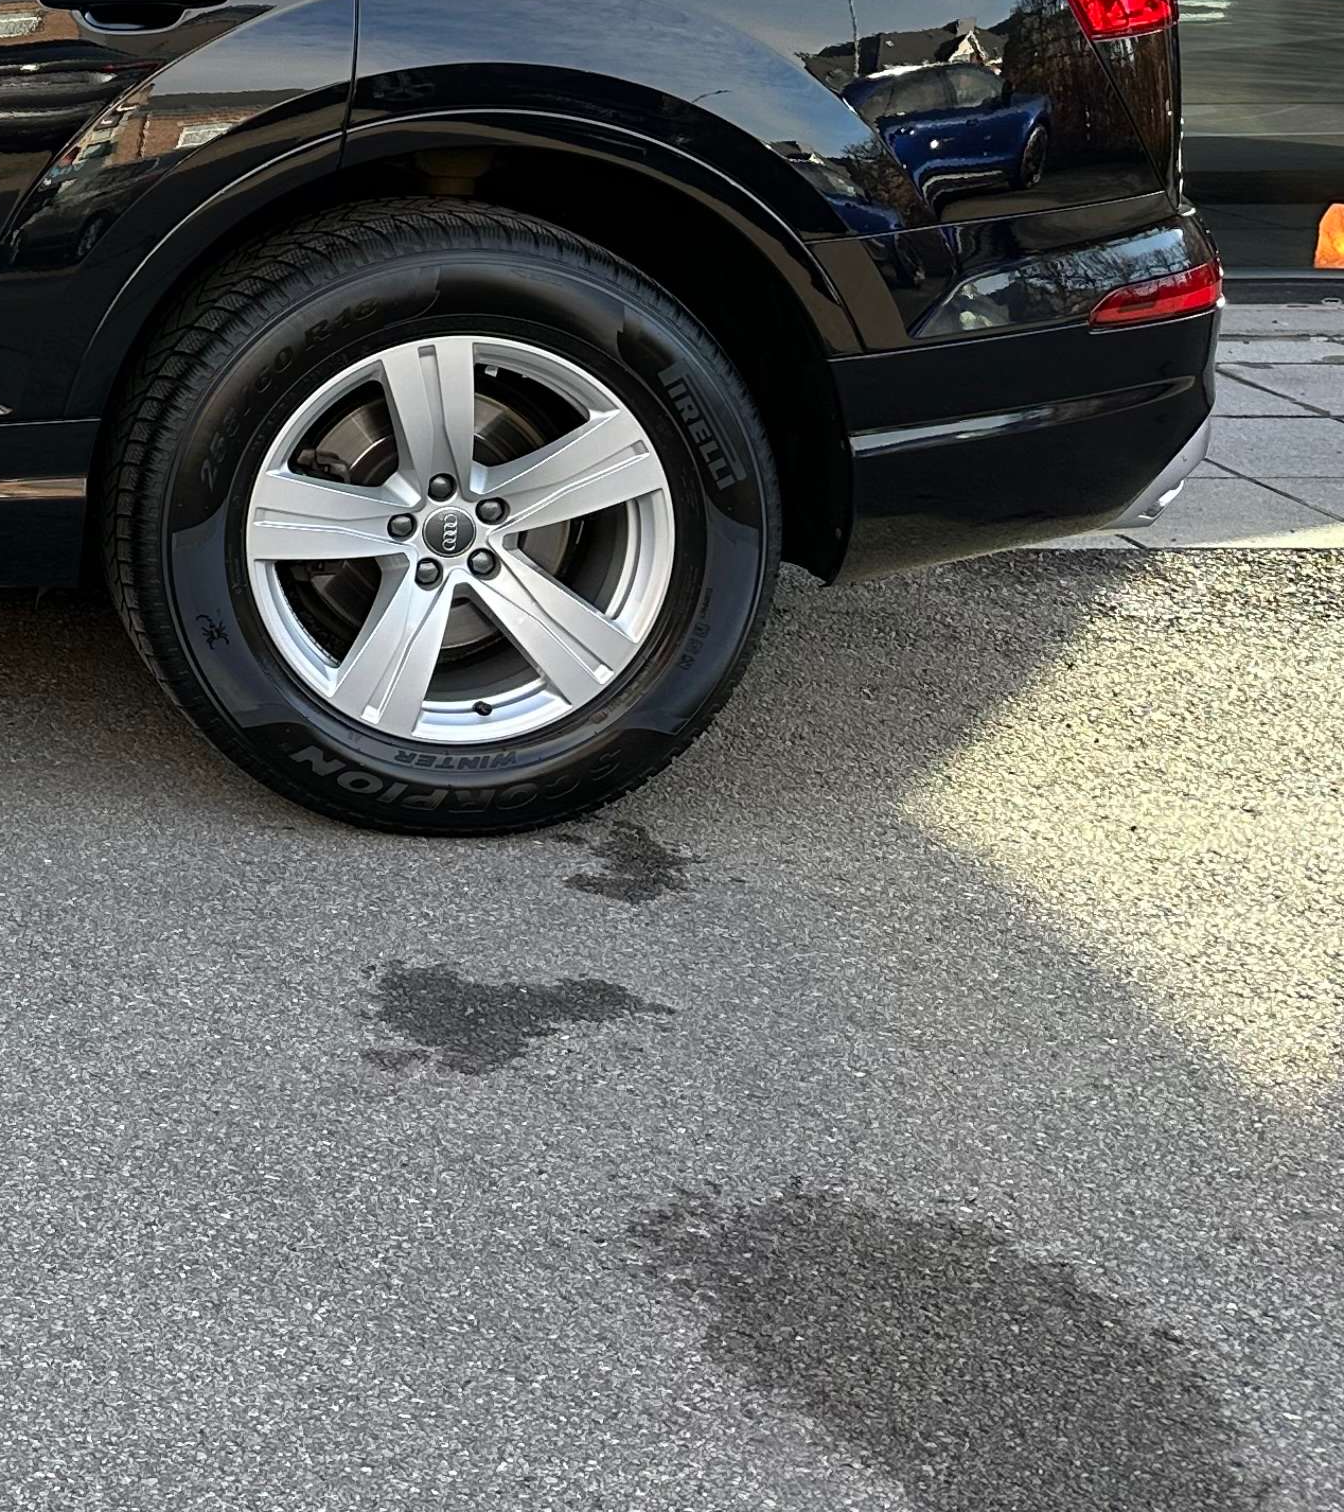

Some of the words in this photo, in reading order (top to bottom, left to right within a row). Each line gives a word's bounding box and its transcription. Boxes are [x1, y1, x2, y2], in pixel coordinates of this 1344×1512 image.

[657, 360, 747, 490] PIRELLI
[289, 745, 623, 813] SCORPION
[394, 749, 516, 771] WINTER
